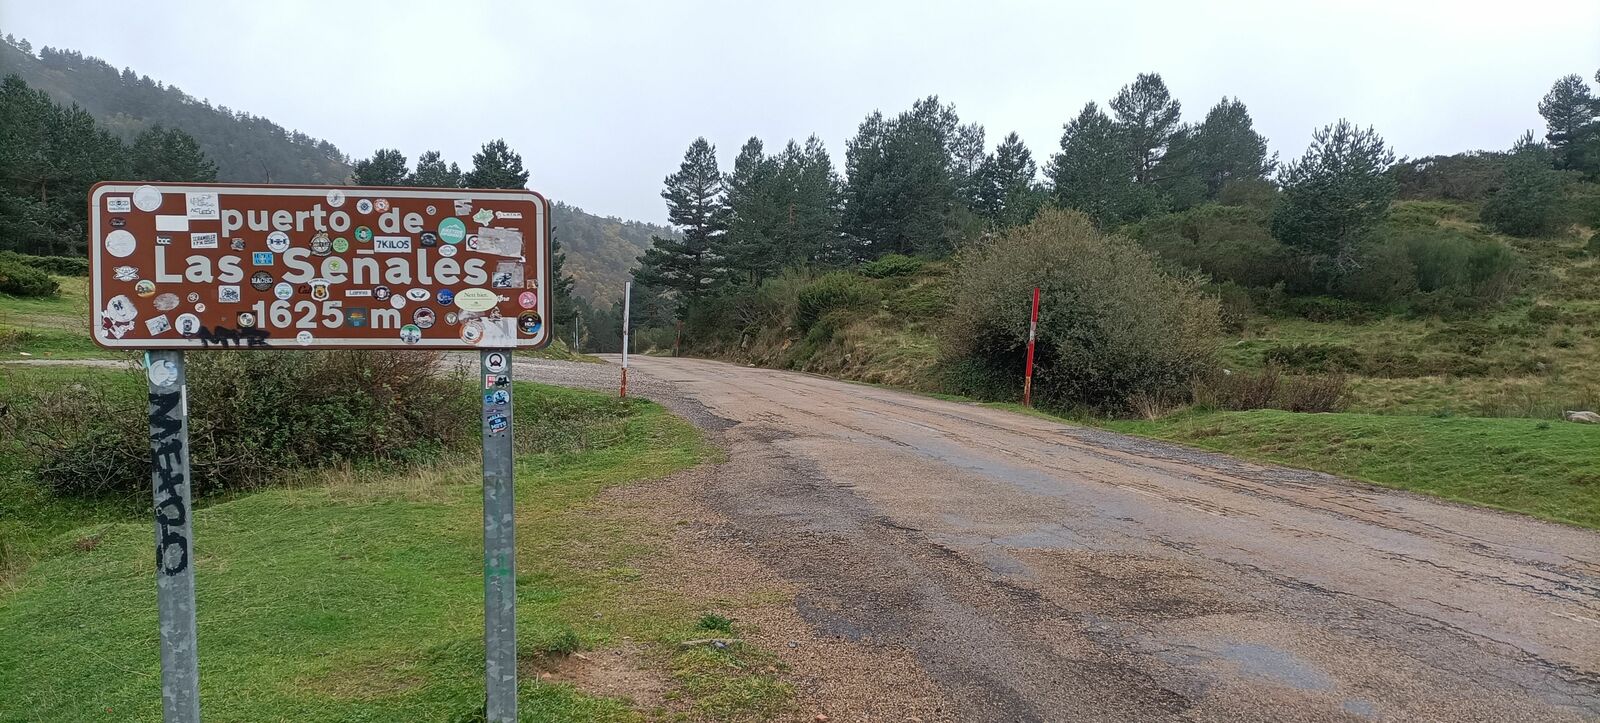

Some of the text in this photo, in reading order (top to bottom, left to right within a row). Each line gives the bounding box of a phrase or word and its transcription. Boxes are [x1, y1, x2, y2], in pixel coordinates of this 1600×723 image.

[221, 203, 424, 238] puerto de
[376, 240, 410, 250] 7KILOS
[155, 245, 488, 286] Las Señales
[252, 300, 344, 329] 1625
[370, 308, 401, 329] m
